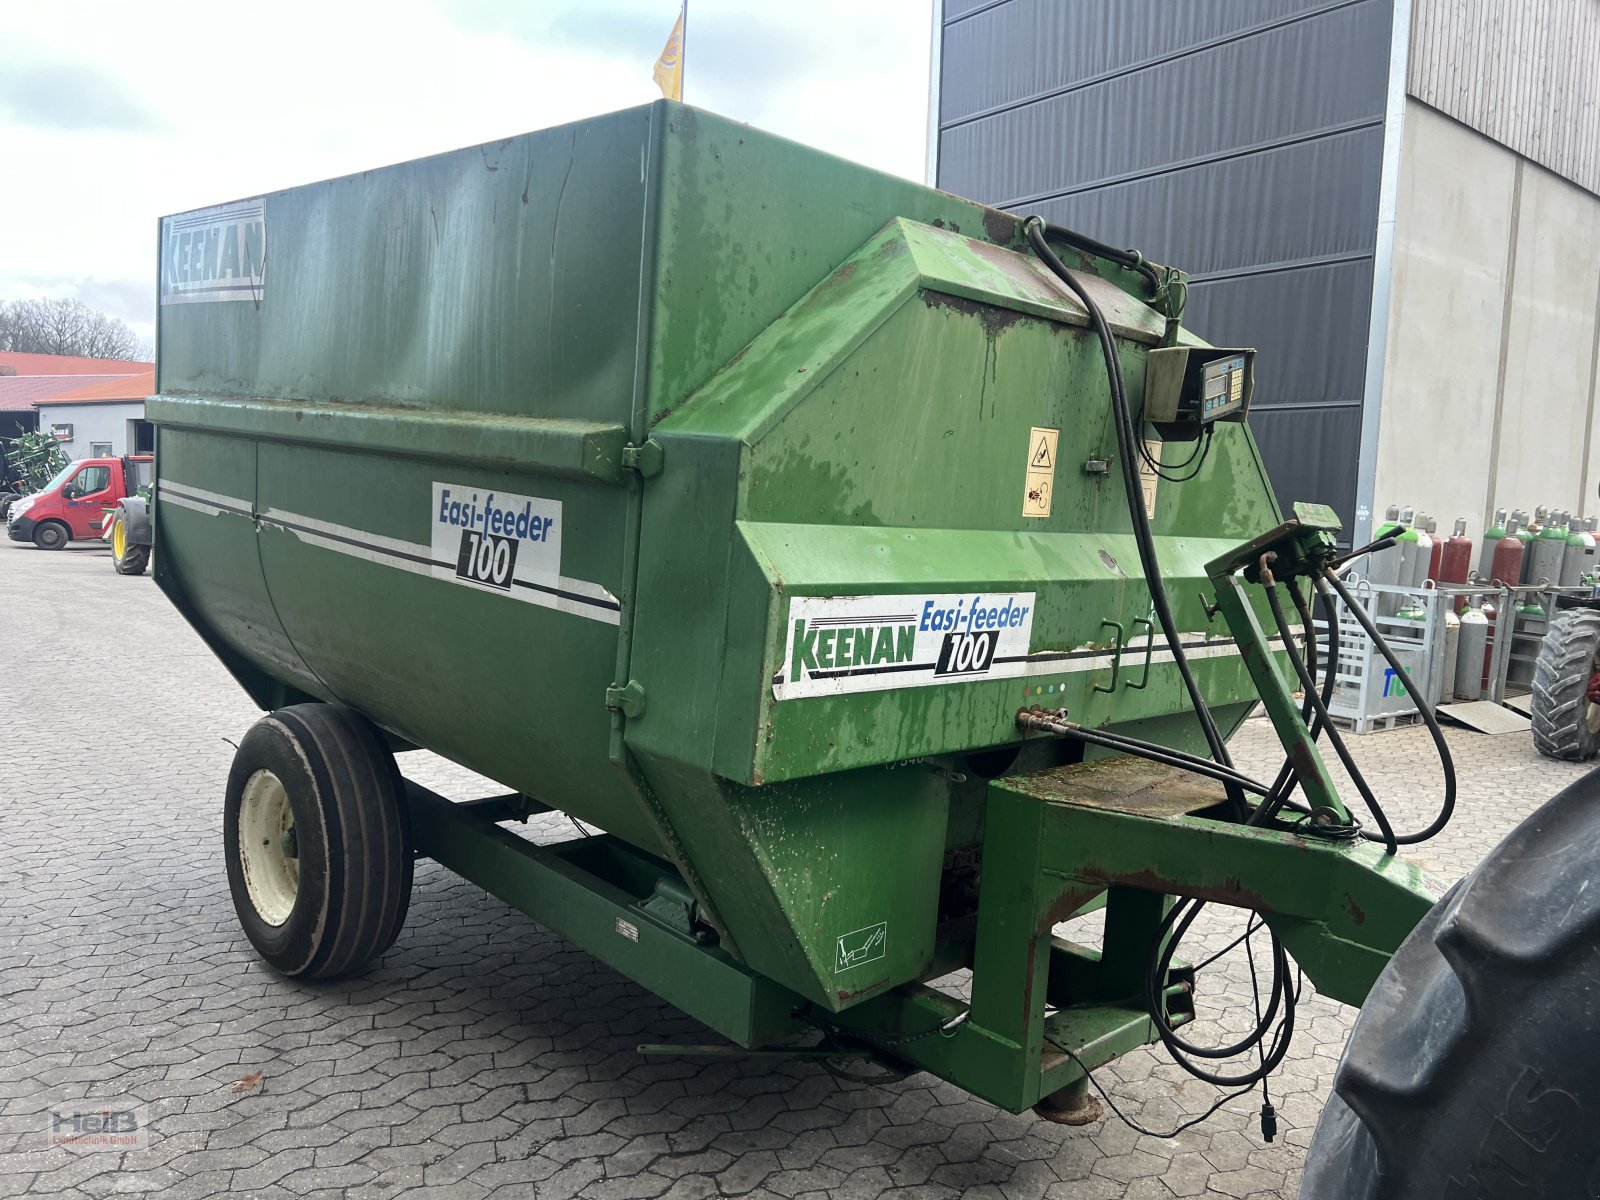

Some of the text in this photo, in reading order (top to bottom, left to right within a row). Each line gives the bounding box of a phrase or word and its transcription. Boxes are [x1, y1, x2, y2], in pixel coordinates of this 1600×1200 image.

[163, 221, 264, 296] KEENAN
[440, 489, 553, 542] Easi-feeder
[467, 532, 511, 584] 100
[919, 596, 1029, 637] Easi-feeder
[790, 618, 916, 682] KEENAN
[946, 632, 990, 672] 100
